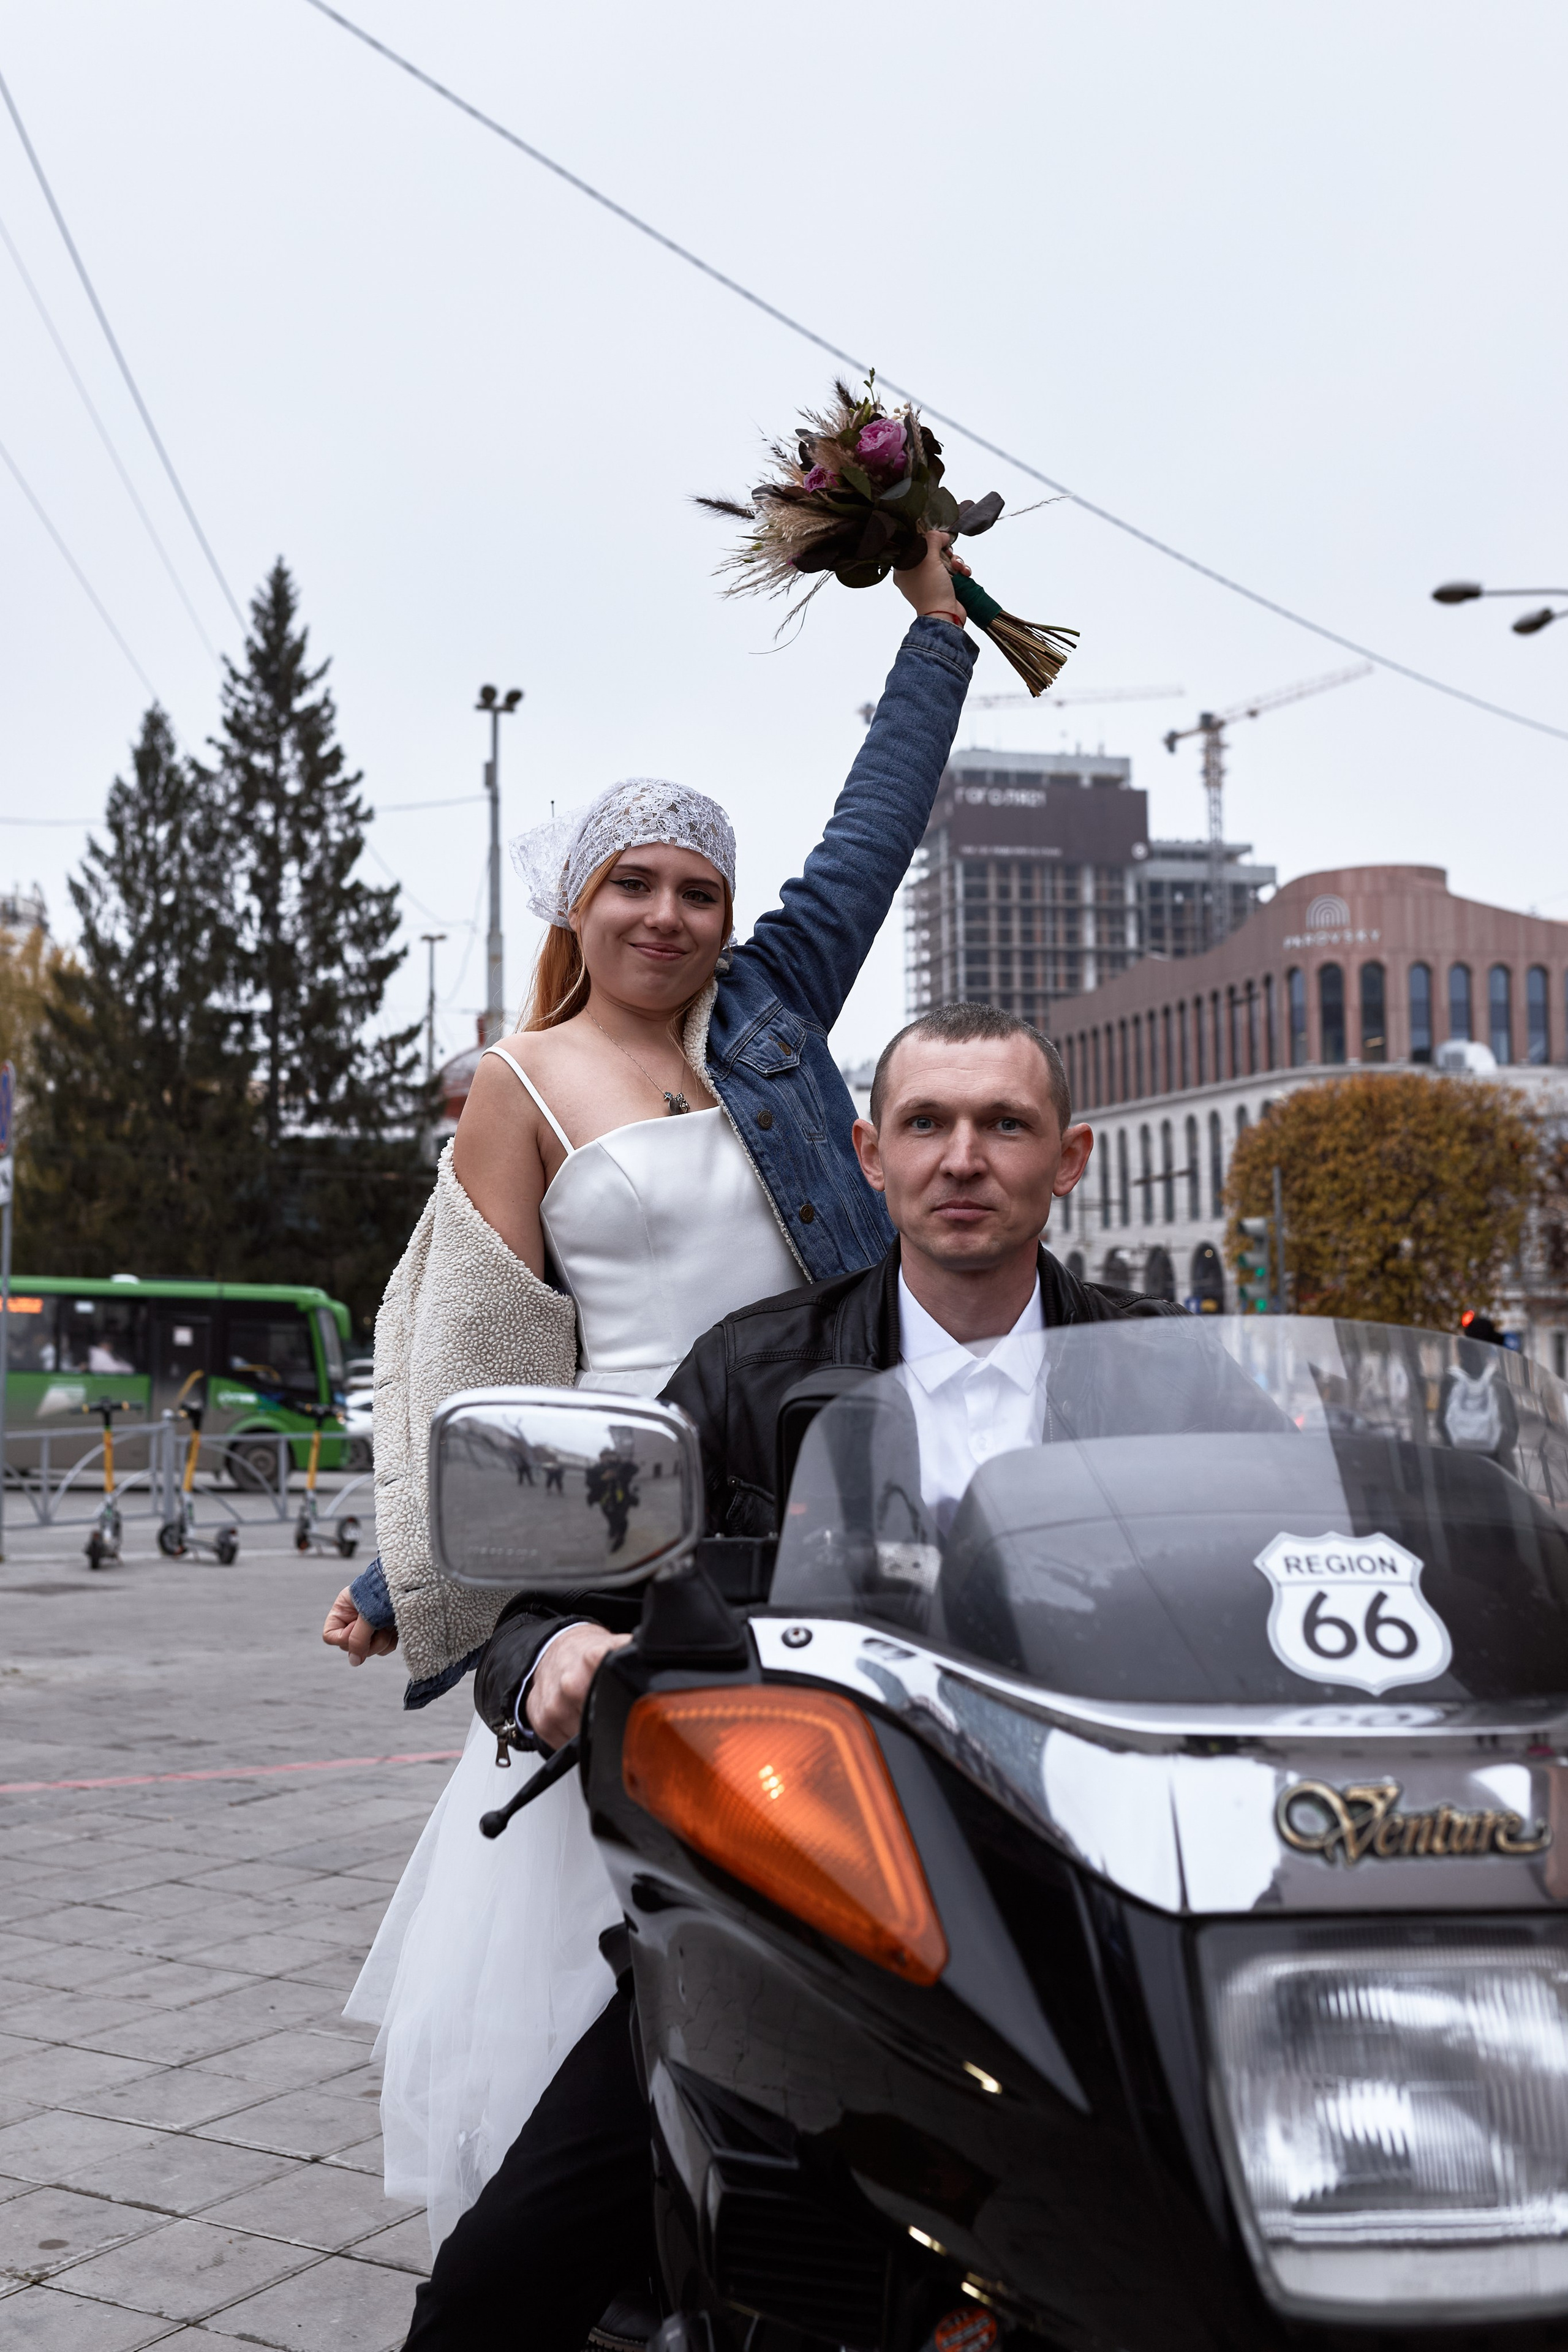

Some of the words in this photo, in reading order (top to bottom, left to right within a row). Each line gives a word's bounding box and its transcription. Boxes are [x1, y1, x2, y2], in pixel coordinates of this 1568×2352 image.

[1283, 1554, 1399, 1576] REGION
[1302, 1590, 1419, 1660] 66
[1276, 1779, 1553, 1865] Venture
